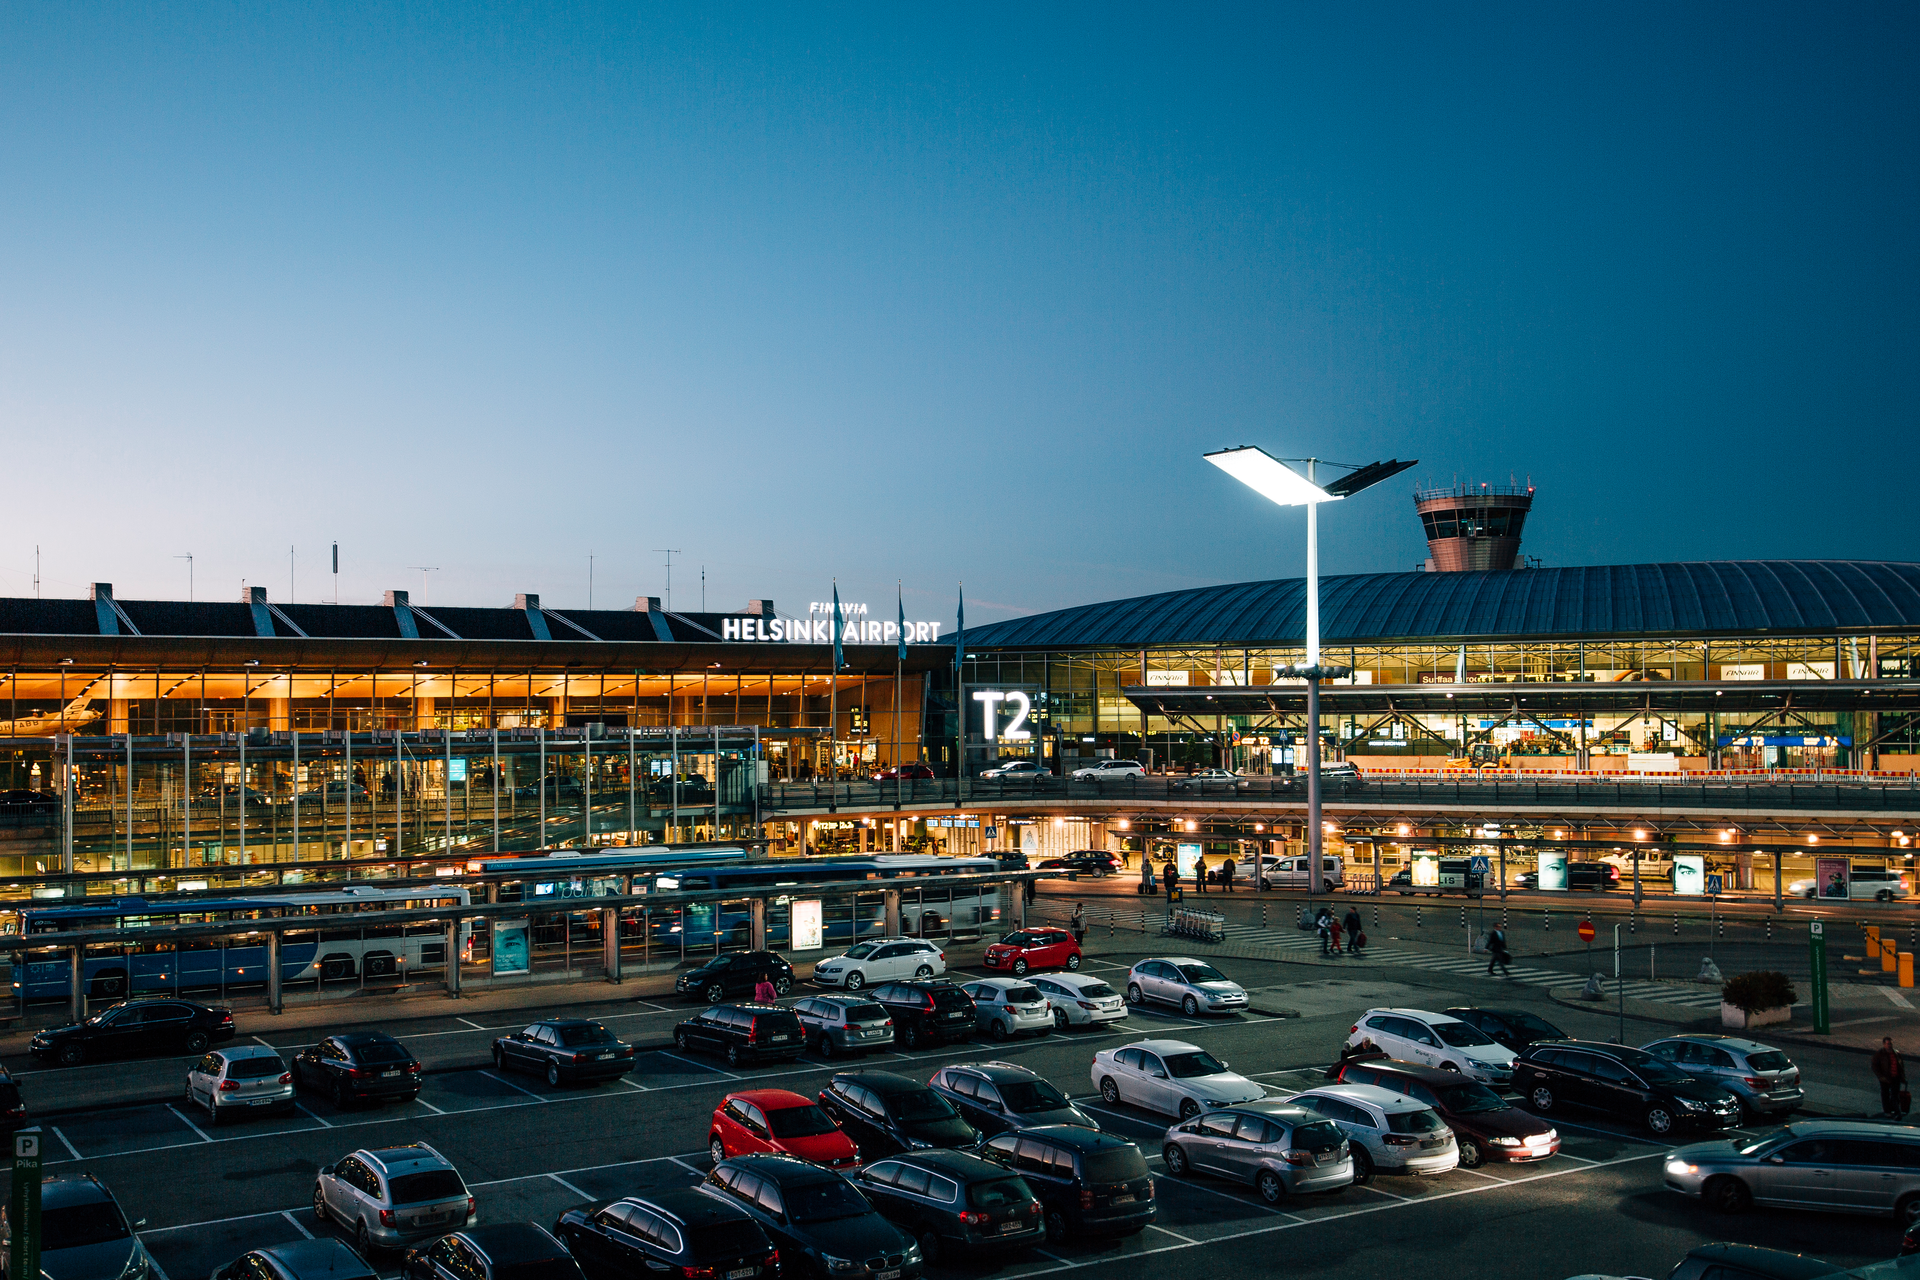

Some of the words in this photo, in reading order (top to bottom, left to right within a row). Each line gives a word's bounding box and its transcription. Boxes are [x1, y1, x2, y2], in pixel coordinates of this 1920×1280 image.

[723, 618, 835, 641] HELSINKI
[842, 620, 941, 642] AIRPORT
[973, 691, 1031, 739] T2
[1258, 736, 1270, 745] T2
[1751, 736, 1764, 746] T2
[16, 1160, 38, 1168] Pika
[22, 1182, 30, 1231] Lyhytaikainen
